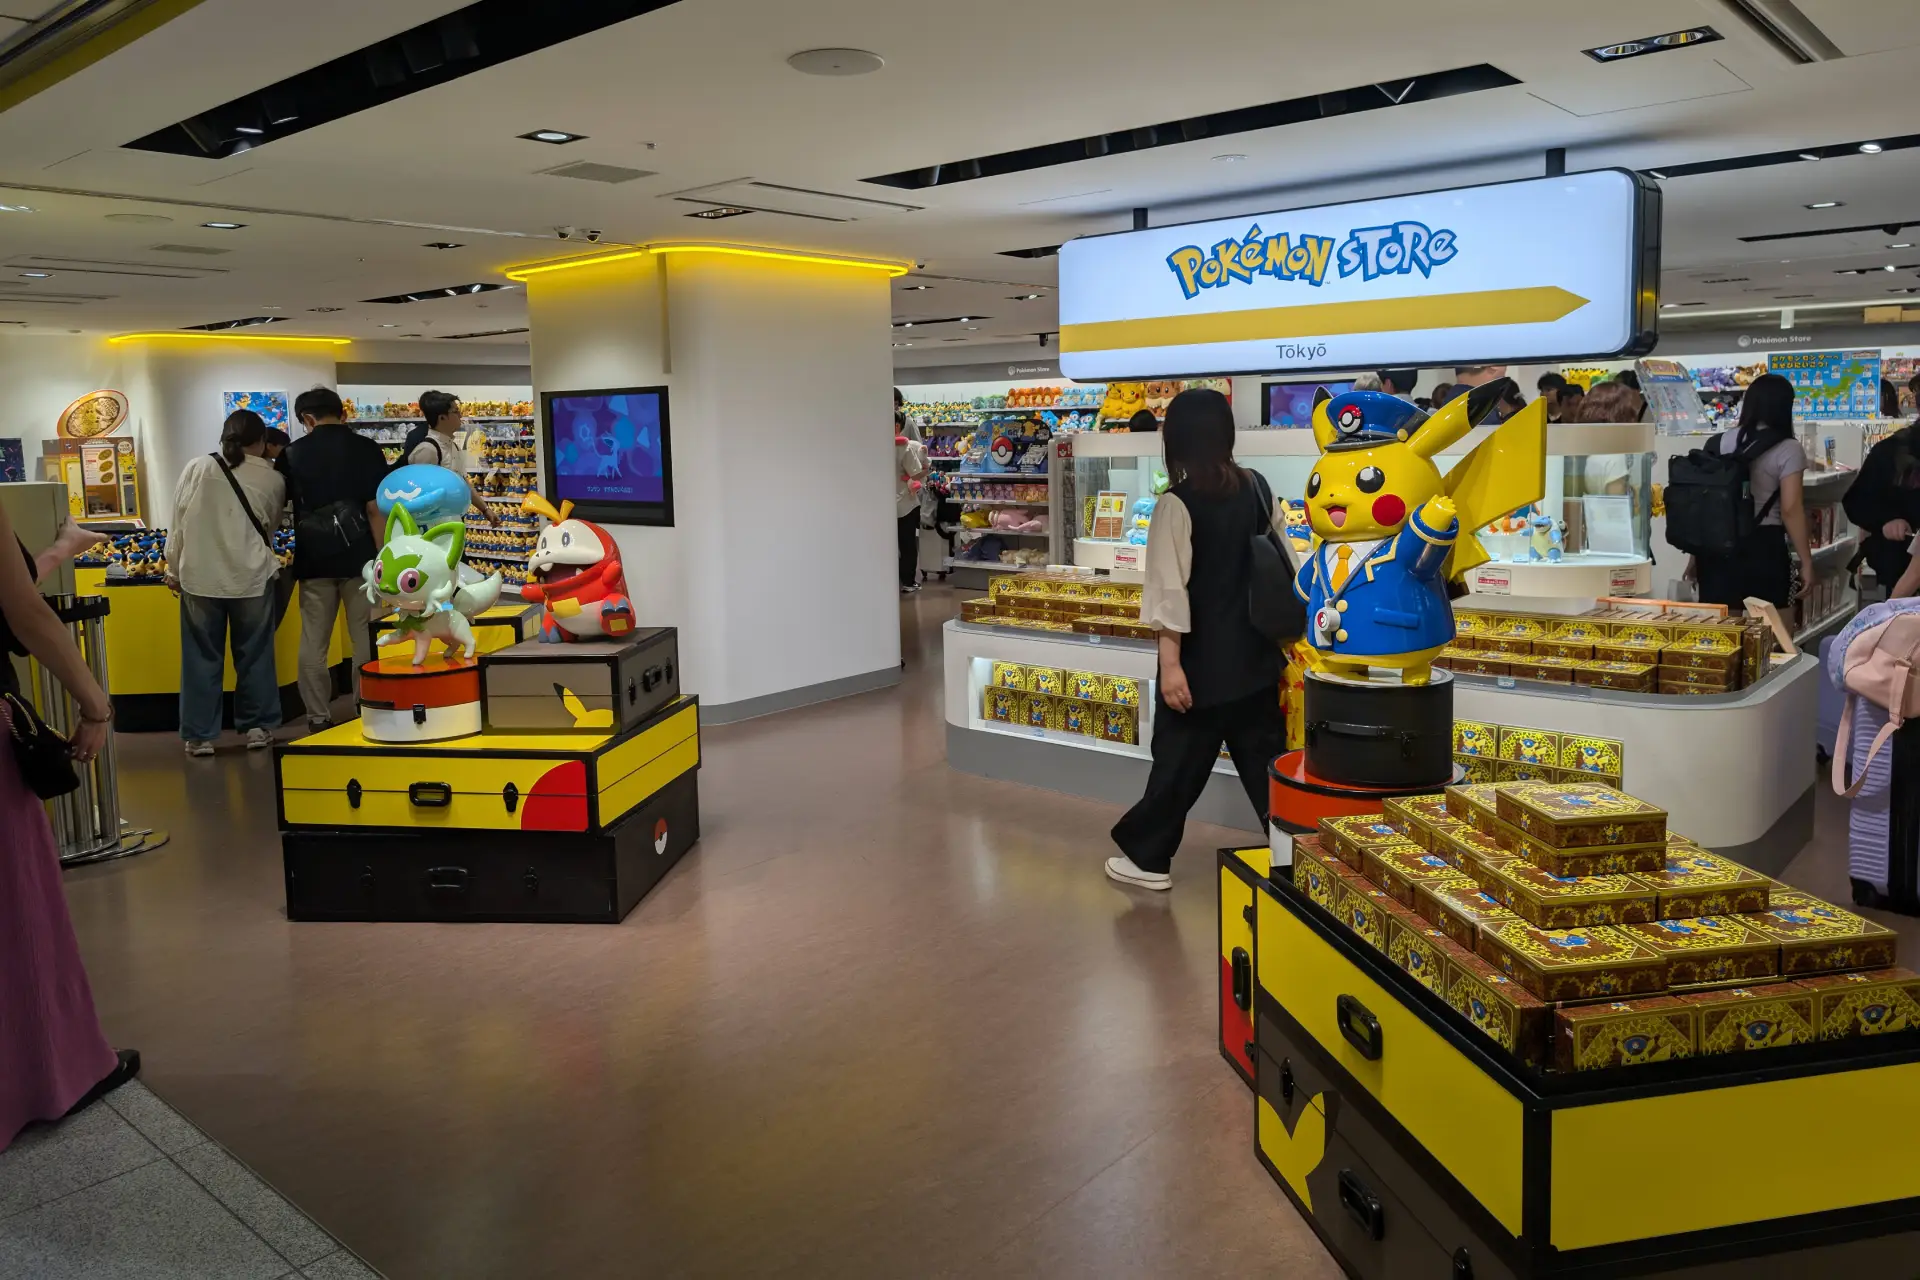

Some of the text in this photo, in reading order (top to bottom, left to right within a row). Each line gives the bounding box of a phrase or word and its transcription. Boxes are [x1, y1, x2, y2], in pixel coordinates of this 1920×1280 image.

[1752, 334, 1812, 345] Pokémon Store
[1276, 342, 1327, 361] Tōkyō
